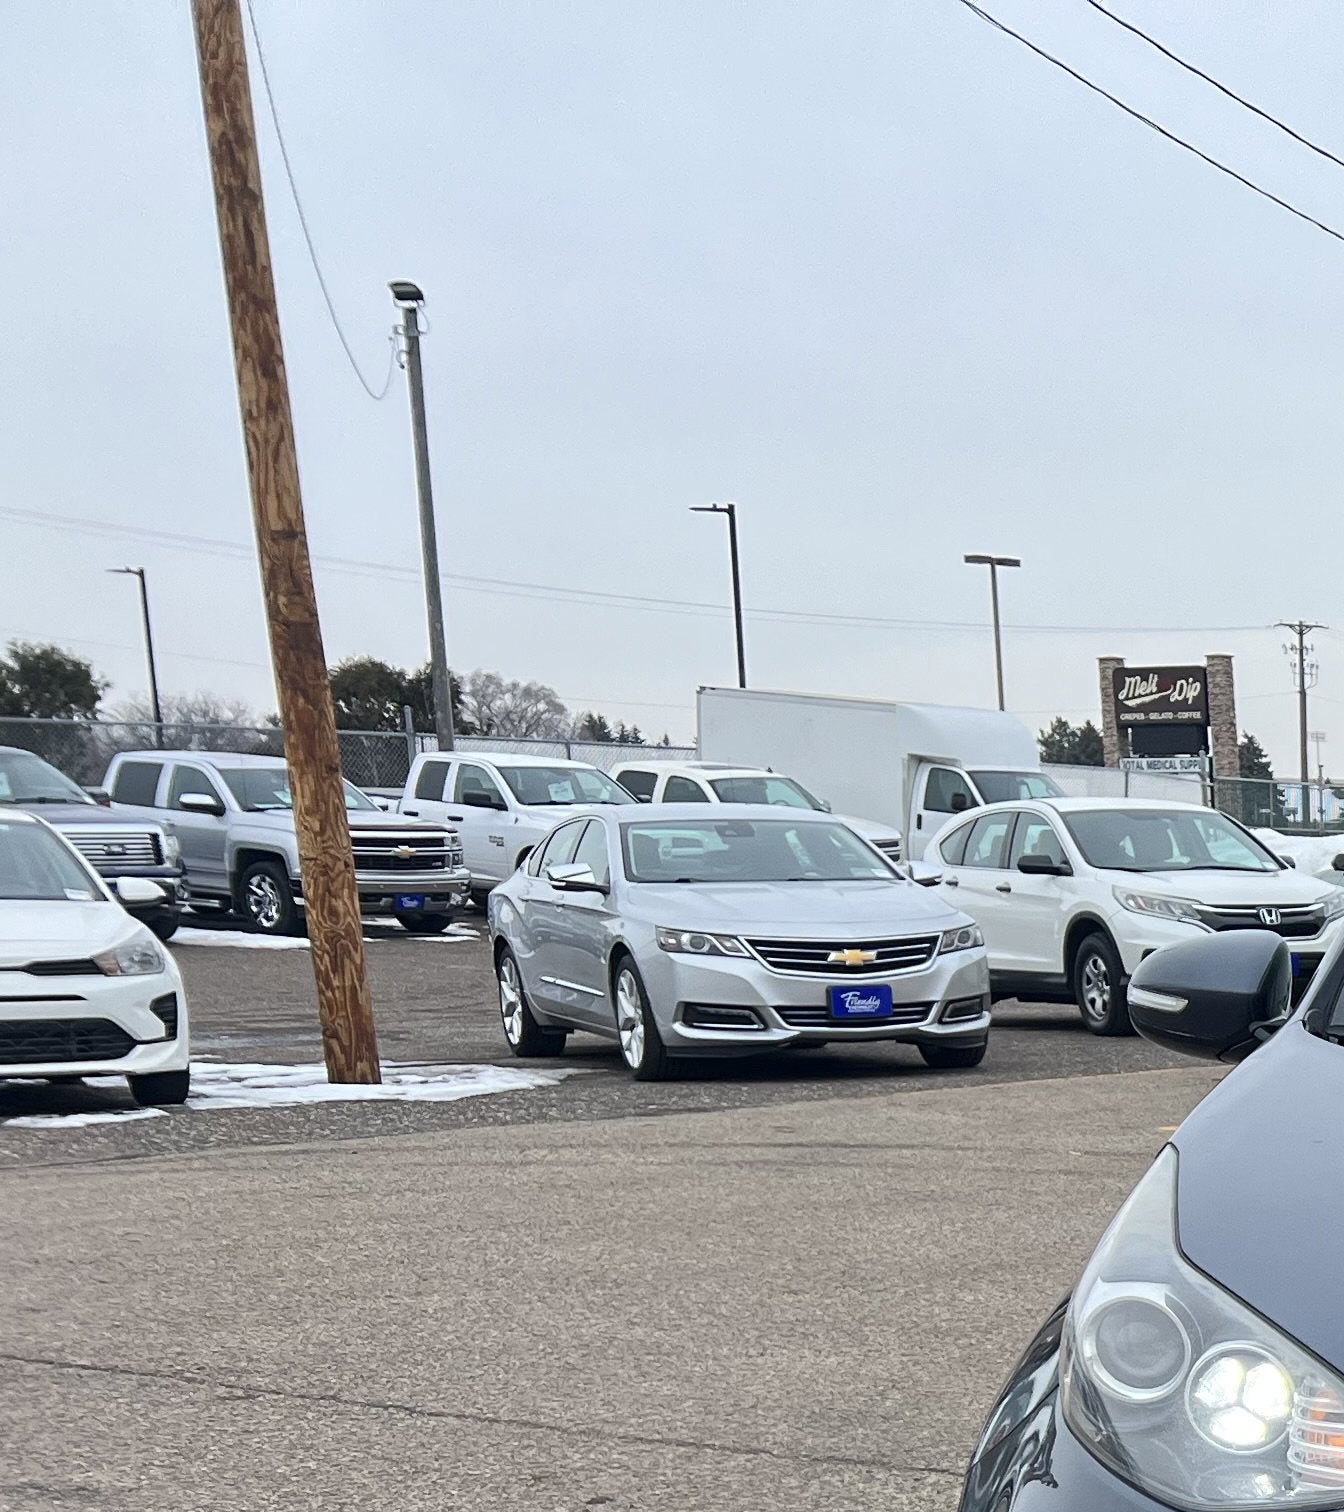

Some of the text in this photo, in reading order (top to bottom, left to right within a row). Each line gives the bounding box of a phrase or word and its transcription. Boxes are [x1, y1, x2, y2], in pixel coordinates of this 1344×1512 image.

[1118, 673, 1201, 704] Melt Dip
[1146, 759, 1177, 770] MEDICAL
